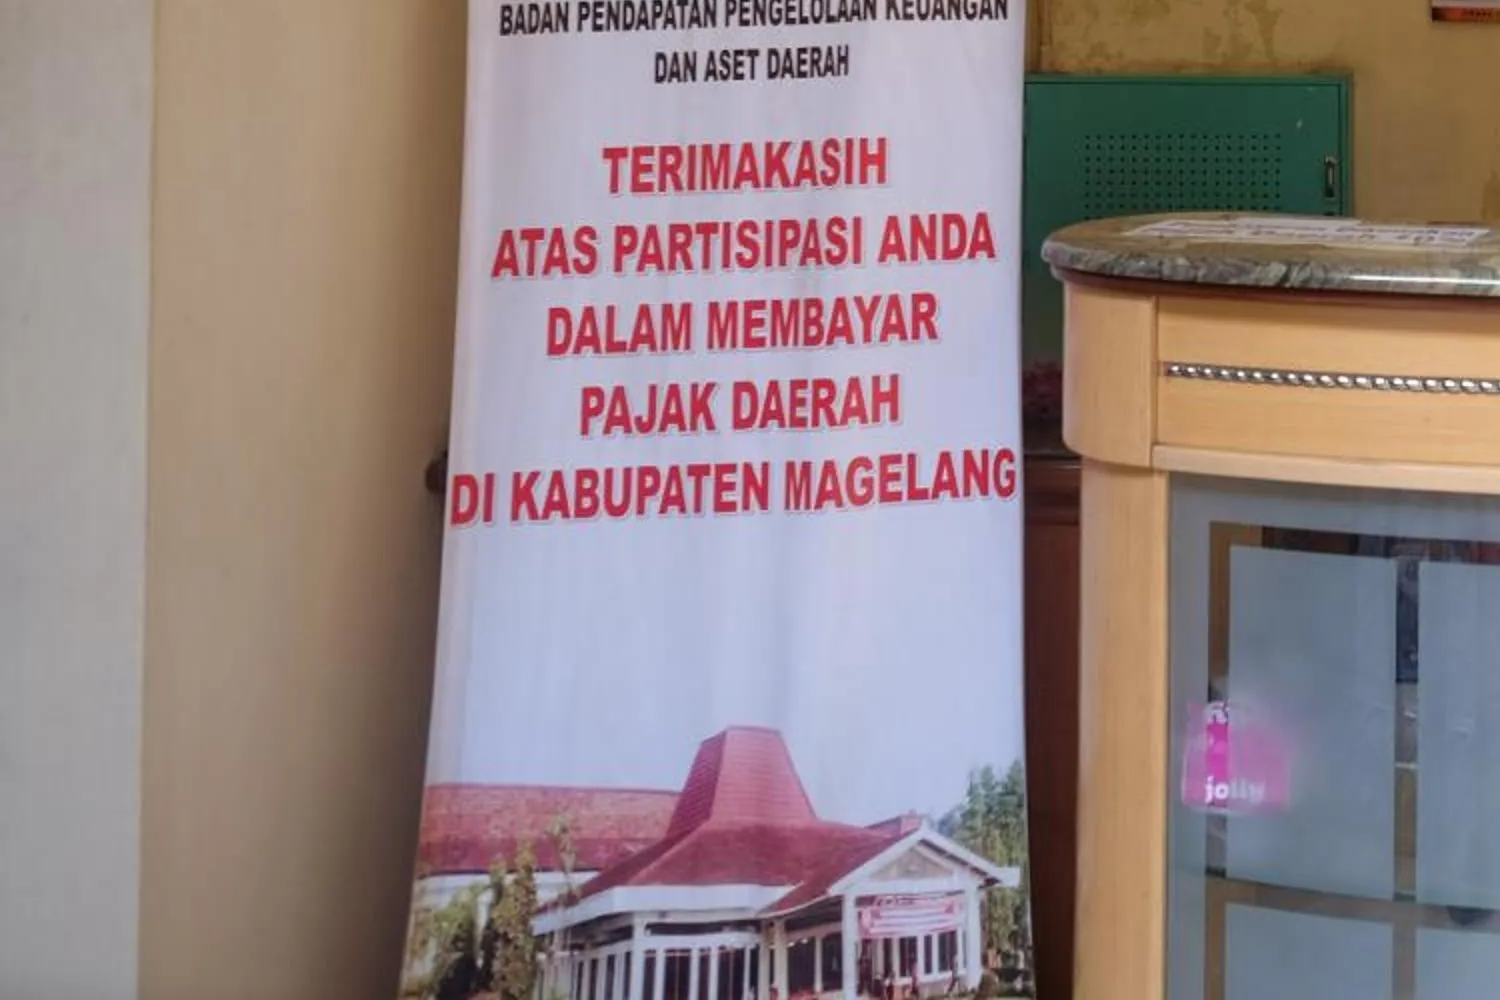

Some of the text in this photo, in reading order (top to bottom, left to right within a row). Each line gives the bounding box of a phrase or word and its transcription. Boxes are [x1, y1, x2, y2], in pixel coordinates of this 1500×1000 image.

[499, 1, 570, 37] BADAN
[654, 44, 849, 84] DAN ASET DAERAH
[603, 137, 887, 193] TERIMAKASIH
[492, 212, 995, 278] ATAS PARTISIPASI ANDA
[547, 292, 937, 356] DALAM MEMBAYAR
[581, 375, 899, 436] PAJAK DAERAH
[450, 449, 1016, 525] DI KABUPATEN MAGELANG
[1205, 776, 1265, 804] jolly
